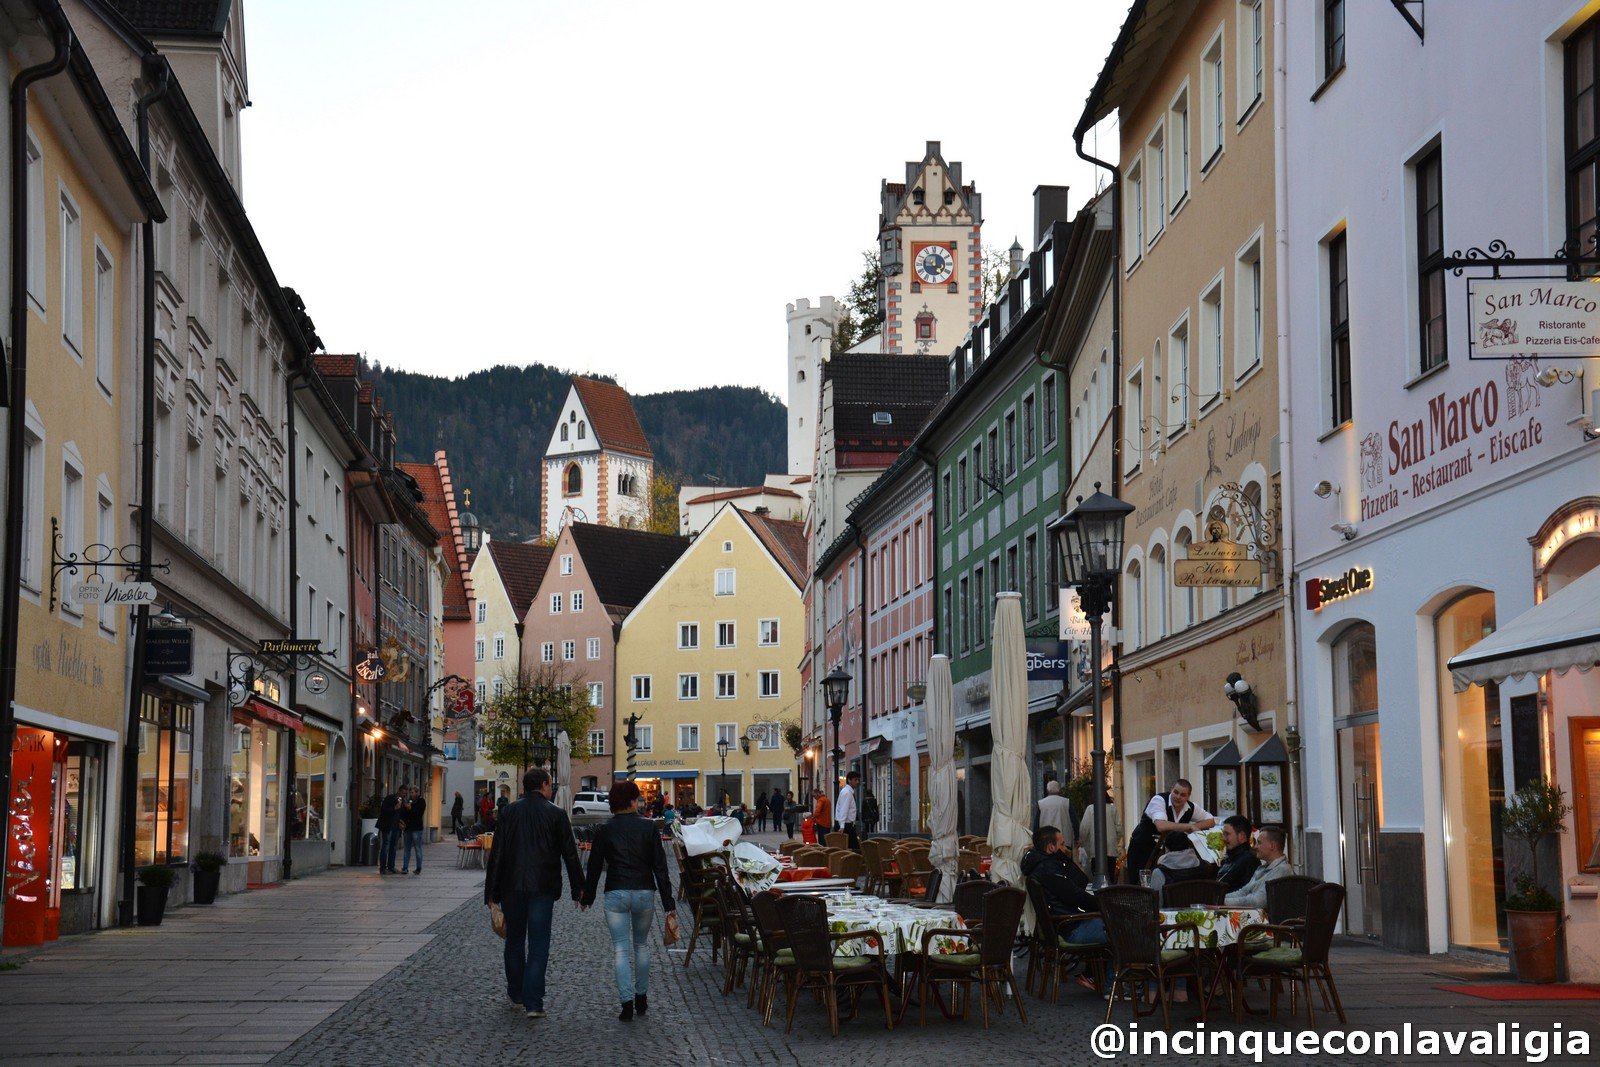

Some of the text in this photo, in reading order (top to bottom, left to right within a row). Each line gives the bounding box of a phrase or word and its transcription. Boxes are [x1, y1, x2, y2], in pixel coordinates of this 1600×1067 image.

[1485, 287, 1597, 316] San Marco
[1539, 321, 1586, 329] Ristorante
[1525, 336, 1600, 346] Pizzeria Eis-Cafe
[1388, 380, 1498, 476] San Marco
[1225, 411, 1262, 462] Ludwigs
[1361, 486, 1399, 522] Pizzeria
[1412, 447, 1473, 499] Restaurant
[1490, 416, 1543, 465] Eiscafe
[1192, 548, 1243, 558] Ludwigs
[1195, 561, 1241, 575] Hotel
[1179, 573, 1259, 586] Restaurant
[104, 582, 153, 604] Niebler
[263, 640, 317, 653] Parfümerie
